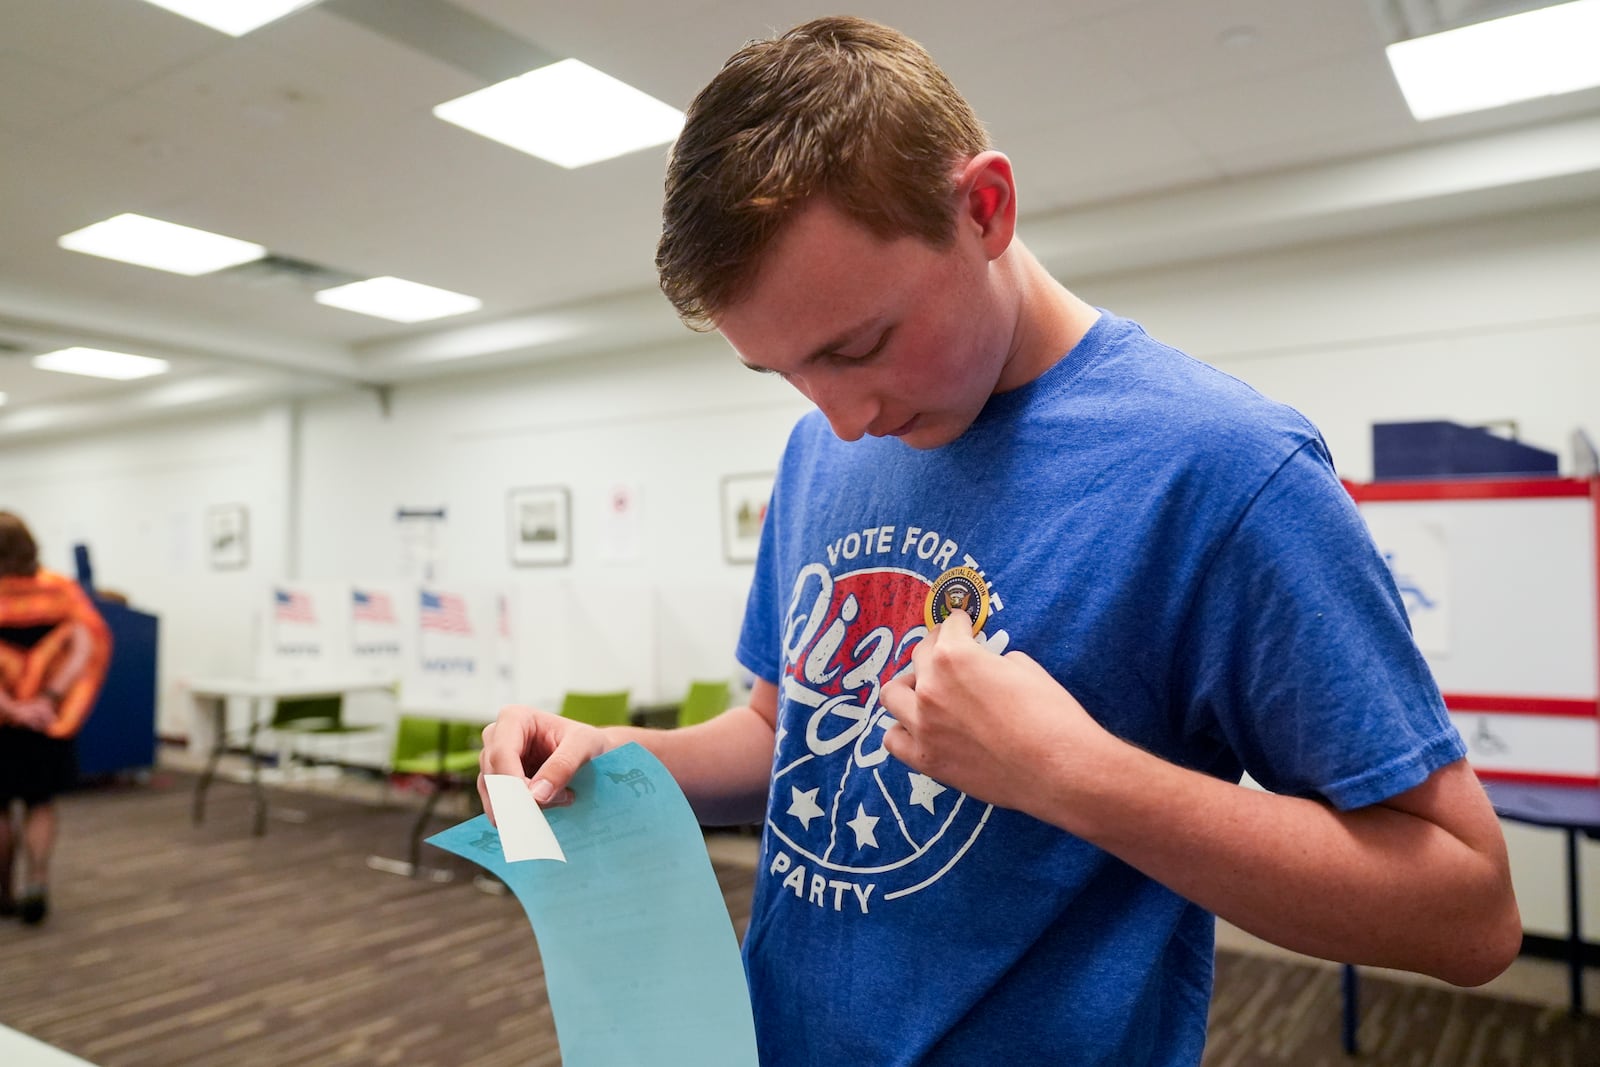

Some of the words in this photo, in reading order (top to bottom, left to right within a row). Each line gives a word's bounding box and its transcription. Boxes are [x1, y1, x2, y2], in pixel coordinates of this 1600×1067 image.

[827, 526, 895, 566] VOTE
[902, 527, 958, 571] FOR
[963, 553, 1004, 617] TE
[931, 568, 965, 593] PRESIDENTIAL
[966, 570, 987, 597] ELECTION
[770, 851, 875, 914] PARTY
